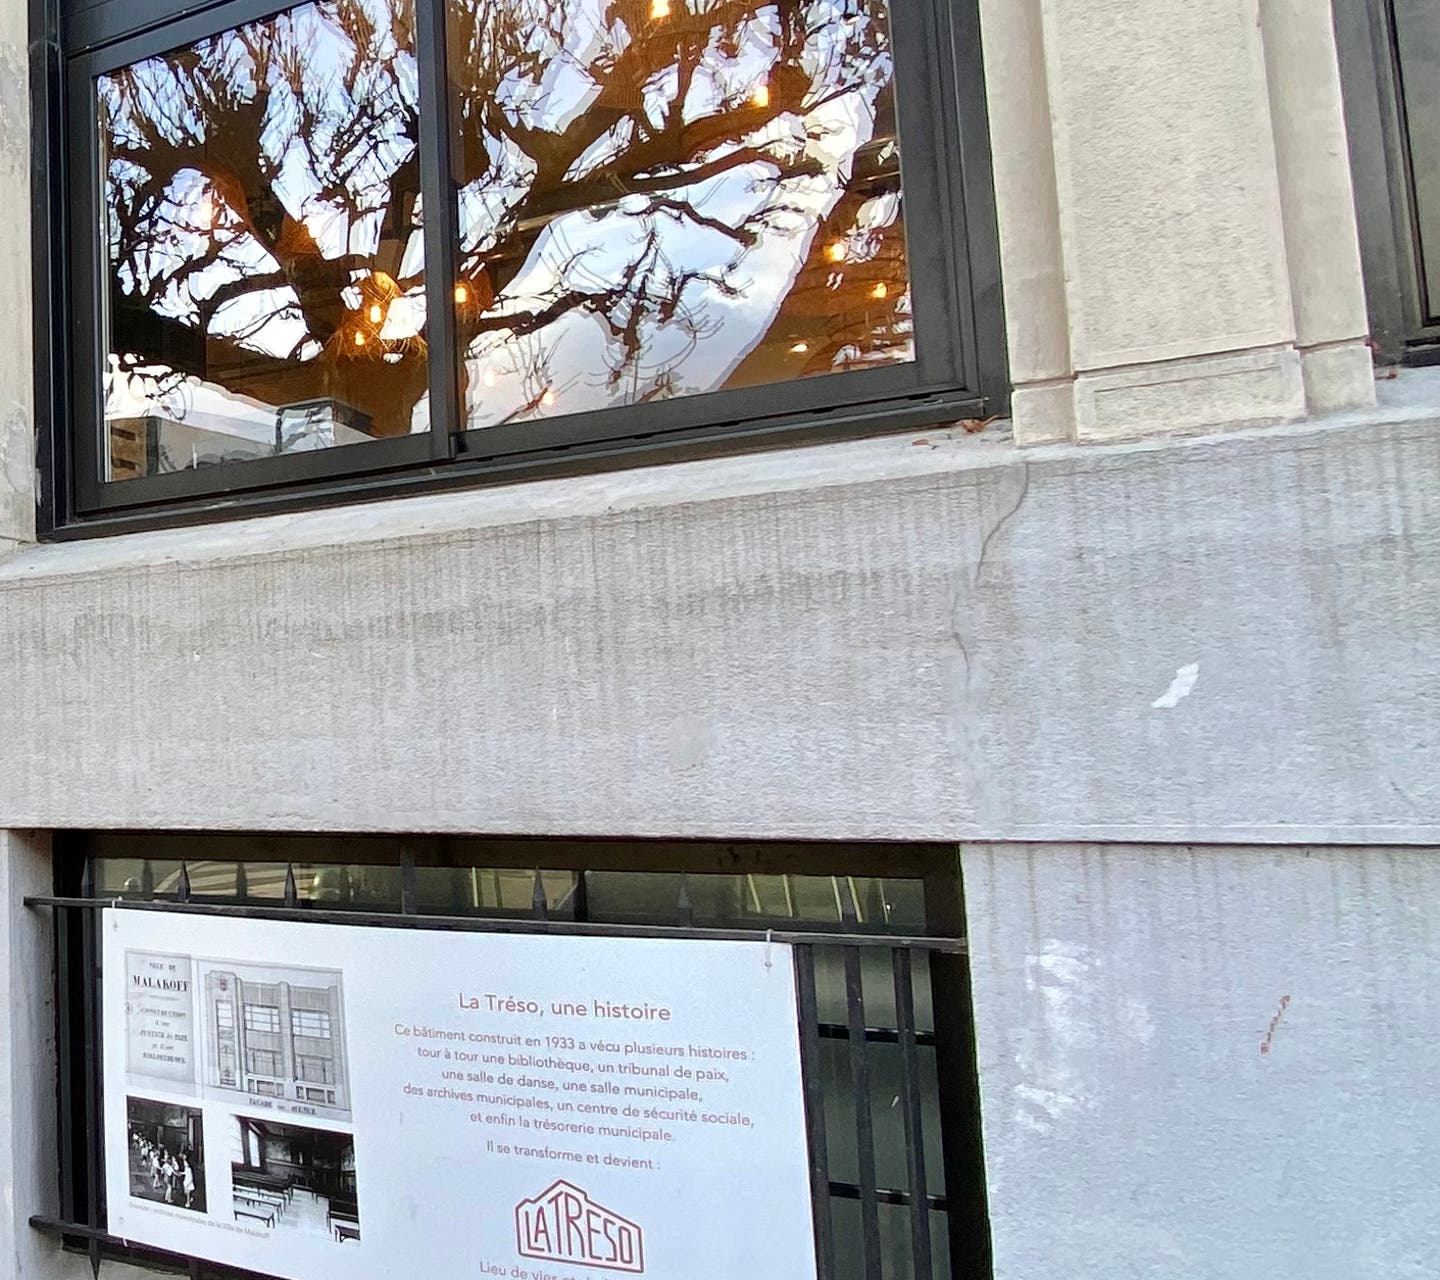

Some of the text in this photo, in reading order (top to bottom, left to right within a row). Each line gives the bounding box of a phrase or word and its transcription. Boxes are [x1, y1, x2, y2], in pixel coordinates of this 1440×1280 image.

[133, 975, 190, 993] MALAKOFF
[458, 992, 671, 1021] La Tréso, une histoire
[394, 1023, 411, 1036] Ce
[413, 1024, 466, 1041] bâtiment
[468, 1031, 522, 1046] construit
[525, 1037, 541, 1047] en
[545, 1036, 575, 1050] 1933
[578, 1040, 586, 1051] a
[590, 1039, 620, 1053] vécu
[624, 1041, 686, 1057] plusieurs
[688, 1043, 748, 1061] histoires
[417, 1046, 730, 1082] tour à tour une bibliothèque, un tribunal de paix,
[442, 1070, 703, 1102] une salle de danse, une salle municipale,
[403, 1083, 755, 1128] des archives municipales, un centre de sécurité sociale,
[470, 1112, 677, 1143] et enfin la trésorerie municipale.
[486, 1140, 494, 1153] Il
[497, 1143, 511, 1154] se
[514, 1145, 583, 1163] transforme
[586, 1152, 599, 1164] et
[603, 1153, 654, 1170] devient
[547, 1190, 634, 1264] TRESO
[479, 1260, 507, 1276] Lieu
[510, 1265, 529, 1280] de
